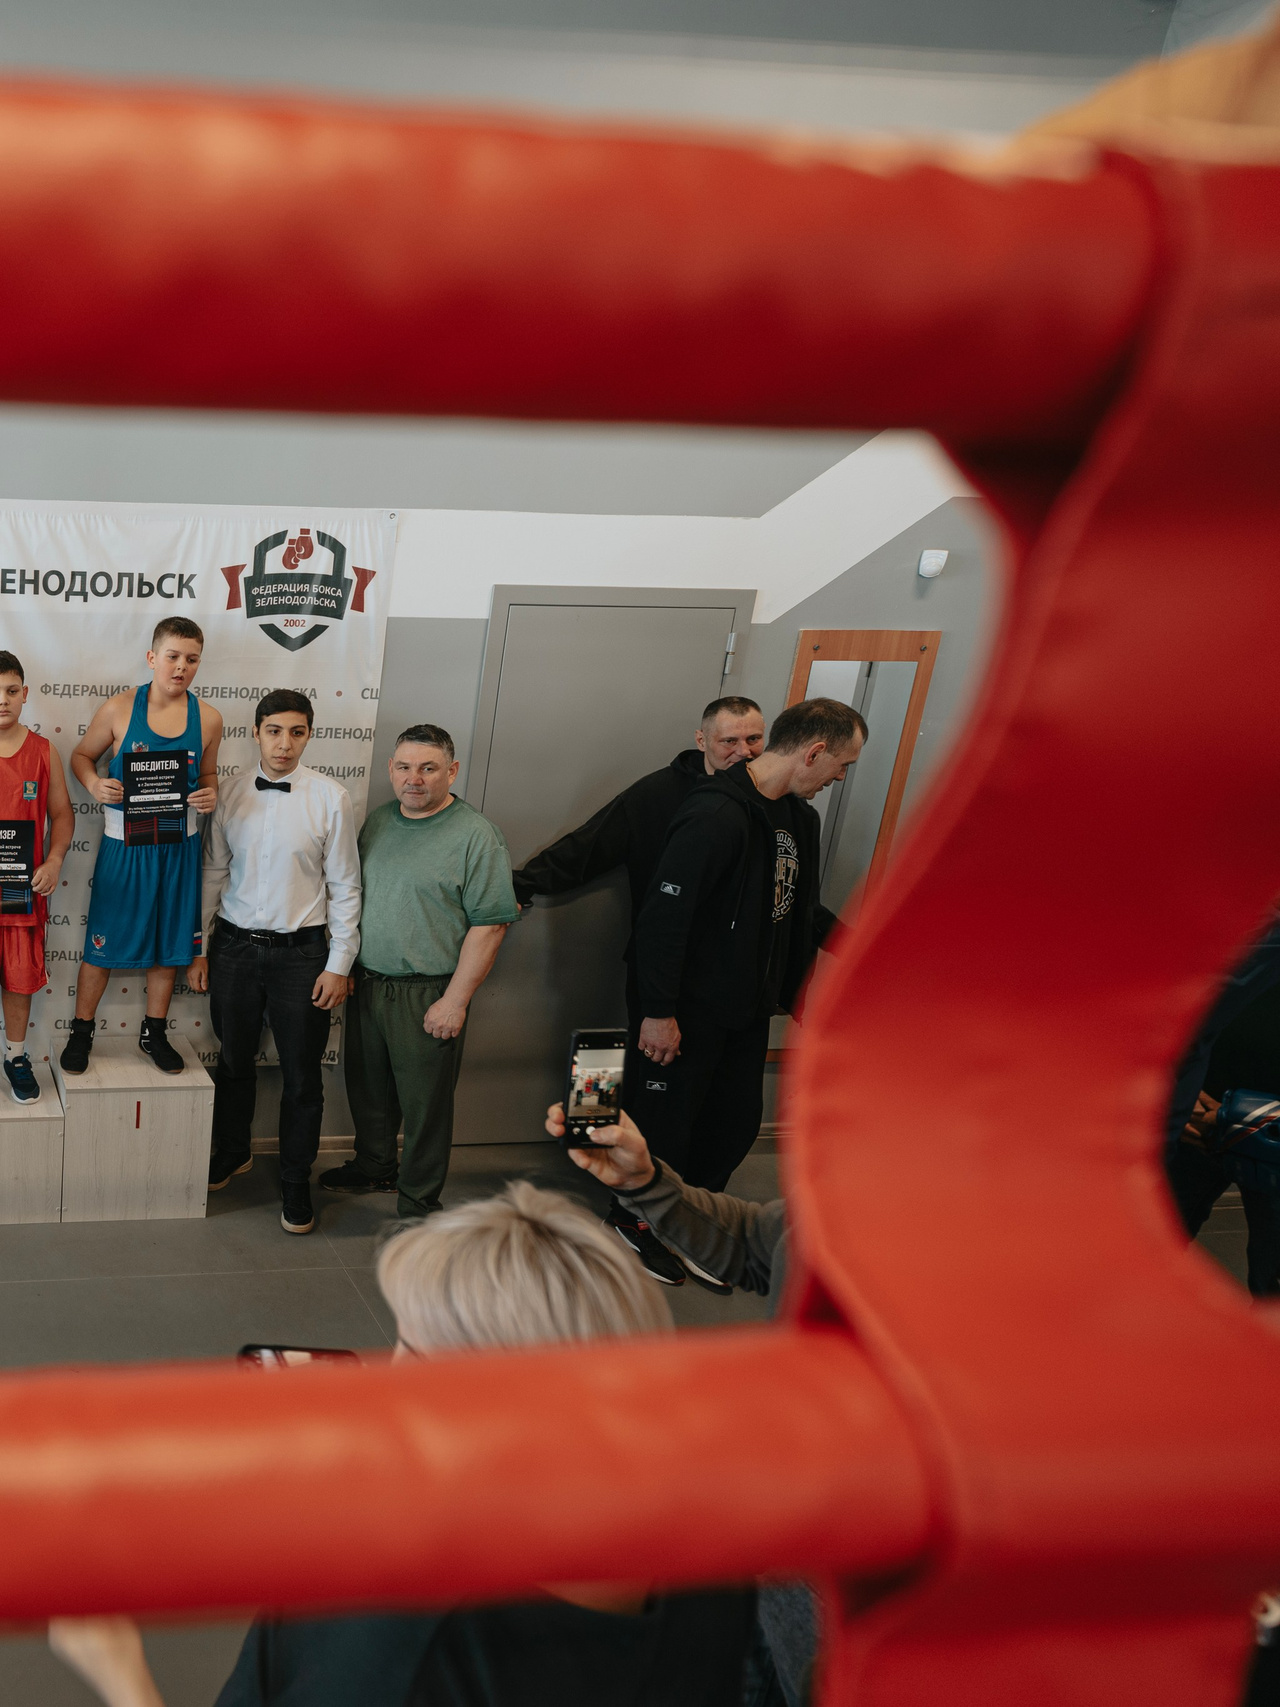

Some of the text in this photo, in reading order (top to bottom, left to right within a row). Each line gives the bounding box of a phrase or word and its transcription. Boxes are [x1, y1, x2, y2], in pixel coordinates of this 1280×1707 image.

[251, 583, 342, 598] ФЕДЕРАЦИЯ БОКСА
[255, 596, 337, 609] ЗЕЛЕНОДОЛЬСКА
[283, 618, 306, 628] 2002
[130, 760, 180, 772] ПОБЕДИТЕЛЬ
